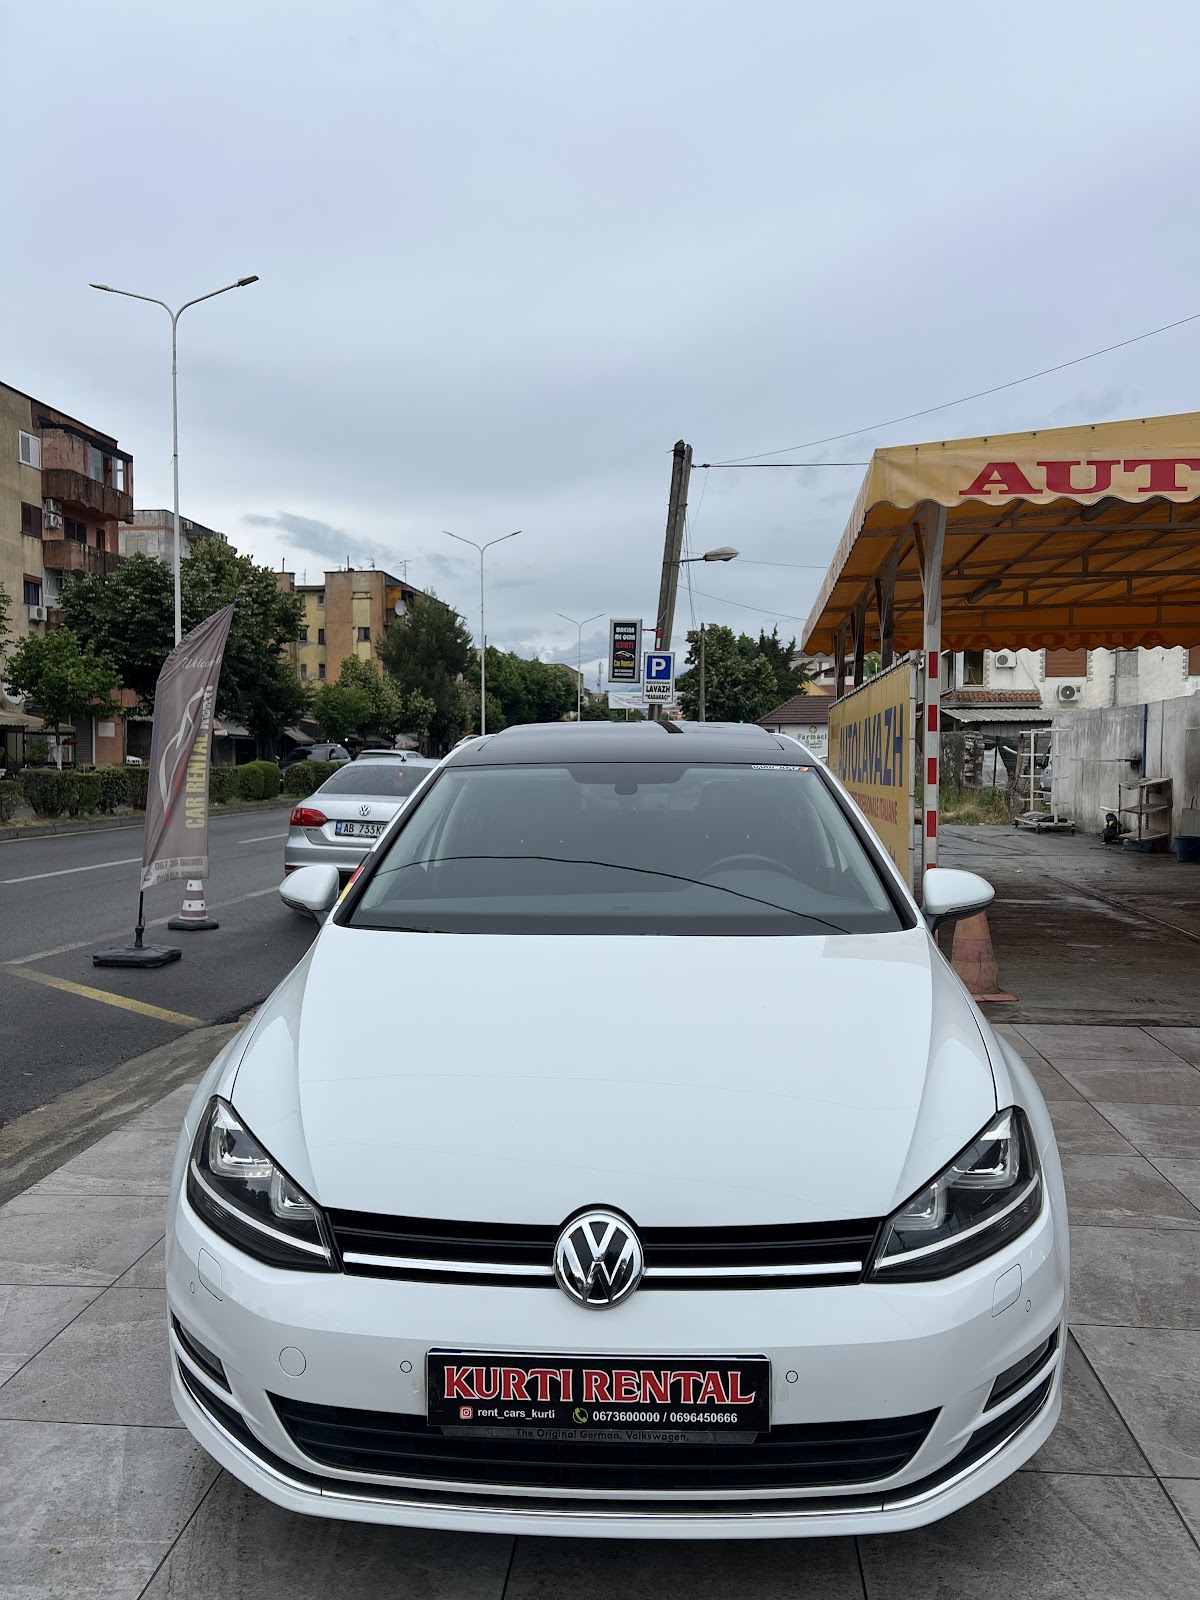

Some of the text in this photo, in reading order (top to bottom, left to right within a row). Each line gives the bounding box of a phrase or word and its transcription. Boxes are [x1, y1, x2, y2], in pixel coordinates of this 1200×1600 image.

[652, 658, 666, 677] P
[646, 685, 670, 693] LAVAZH
[185, 797, 206, 829] CAR
[343, 824, 355, 833] AB
[444, 1365, 757, 1405] KURTI RENTAL
[477, 1407, 556, 1421] rent_cars_kurti
[592, 1410, 661, 1423] 0673600000
[669, 1411, 738, 1424] 0696450666
[516, 1428, 690, 1442] The Original German. Volkswagen.
